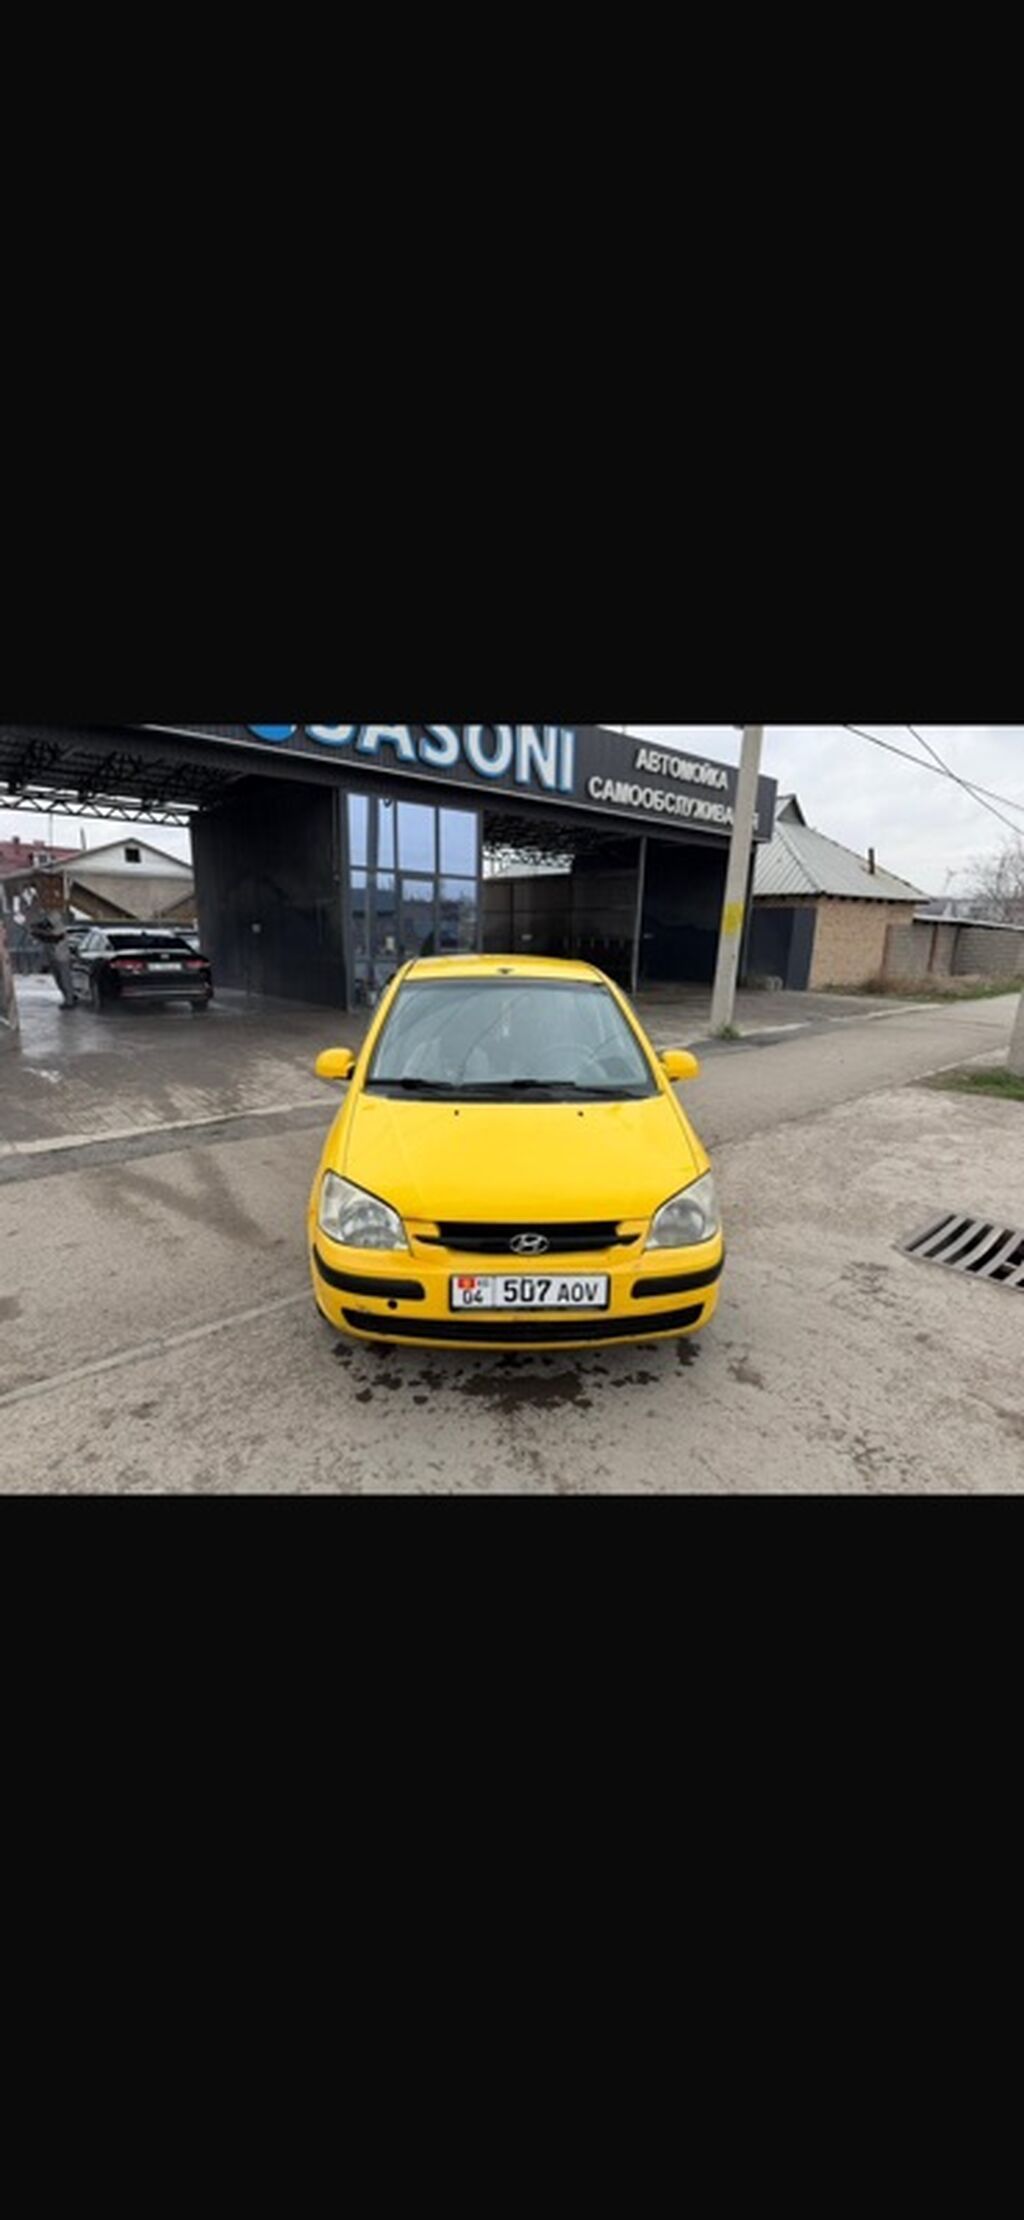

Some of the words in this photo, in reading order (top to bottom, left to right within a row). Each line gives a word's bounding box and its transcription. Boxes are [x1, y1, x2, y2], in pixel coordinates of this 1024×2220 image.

[635, 748, 729, 790] АВТОМОЙКА
[462, 1290, 484, 1305] 04
[503, 1279, 552, 1302] 507
[557, 1283, 598, 1302] AOV
